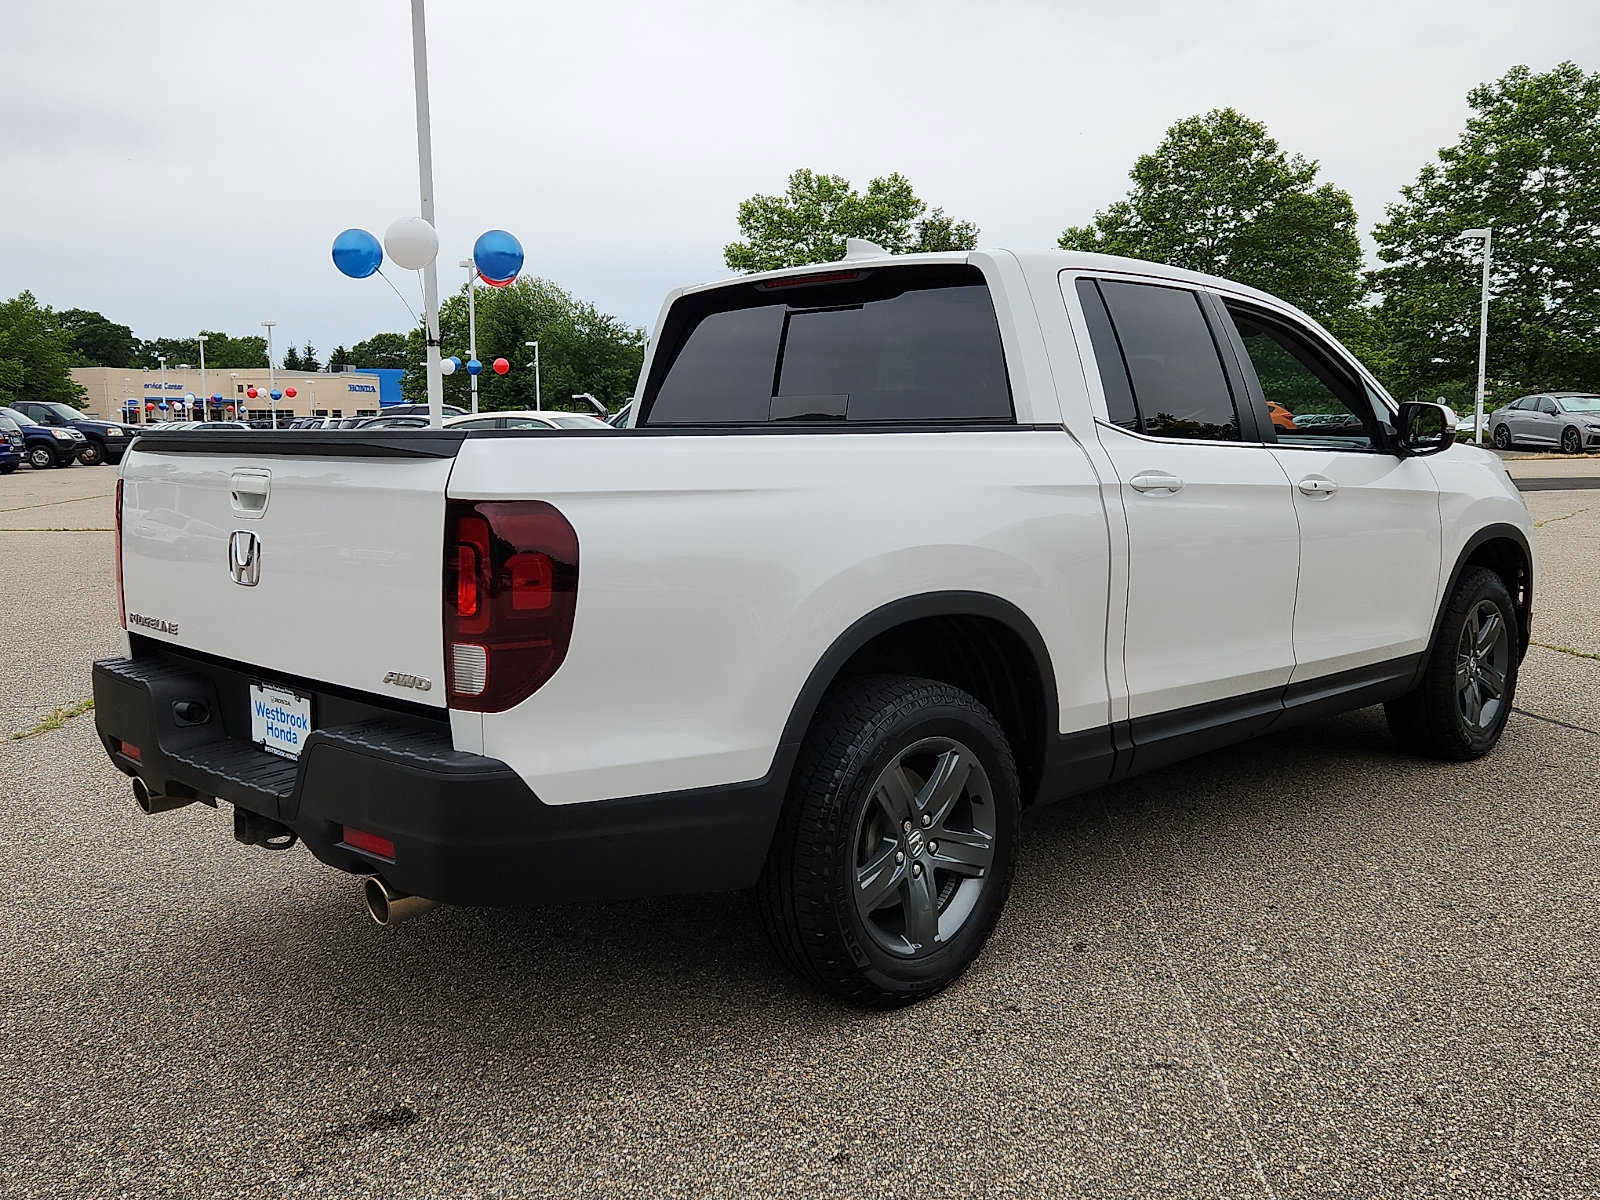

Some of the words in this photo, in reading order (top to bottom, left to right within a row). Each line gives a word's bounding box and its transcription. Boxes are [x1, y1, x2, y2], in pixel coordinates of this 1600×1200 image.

[348, 384, 376, 392] HONDA
[383, 670, 432, 691] AWD
[255, 700, 308, 731] Westbrook
[266, 720, 298, 745] Honda
